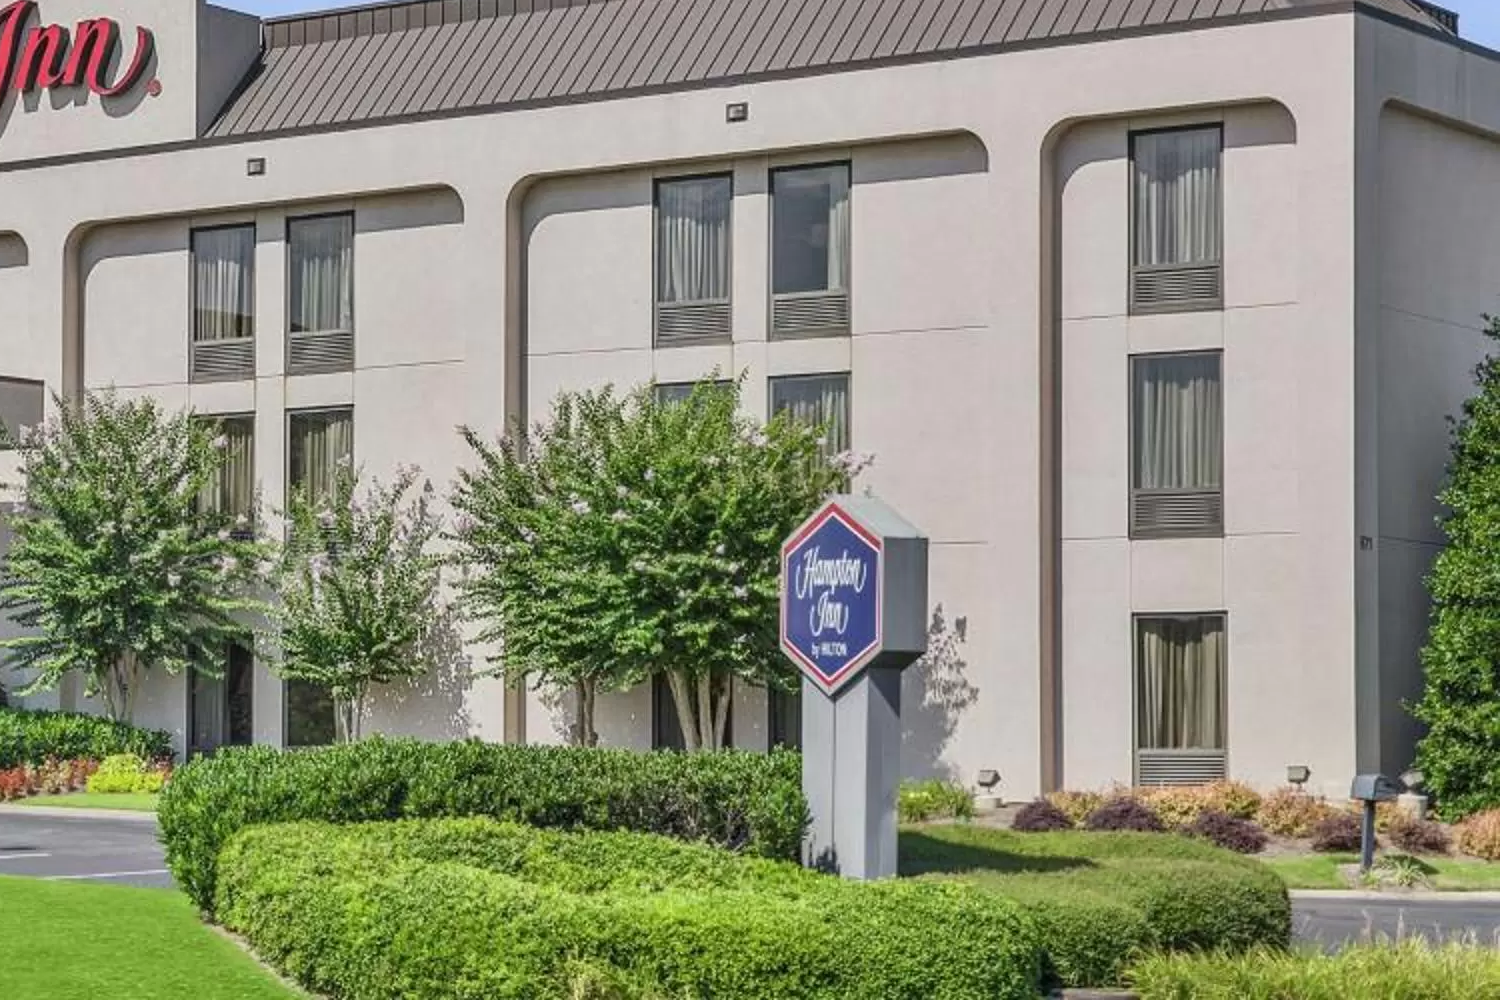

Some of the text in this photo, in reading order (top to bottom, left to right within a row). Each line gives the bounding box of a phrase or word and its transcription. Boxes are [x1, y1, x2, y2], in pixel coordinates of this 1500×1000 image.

[796, 546, 867, 599] Hampton
[810, 592, 849, 637] Inn
[812, 641, 819, 659] by
